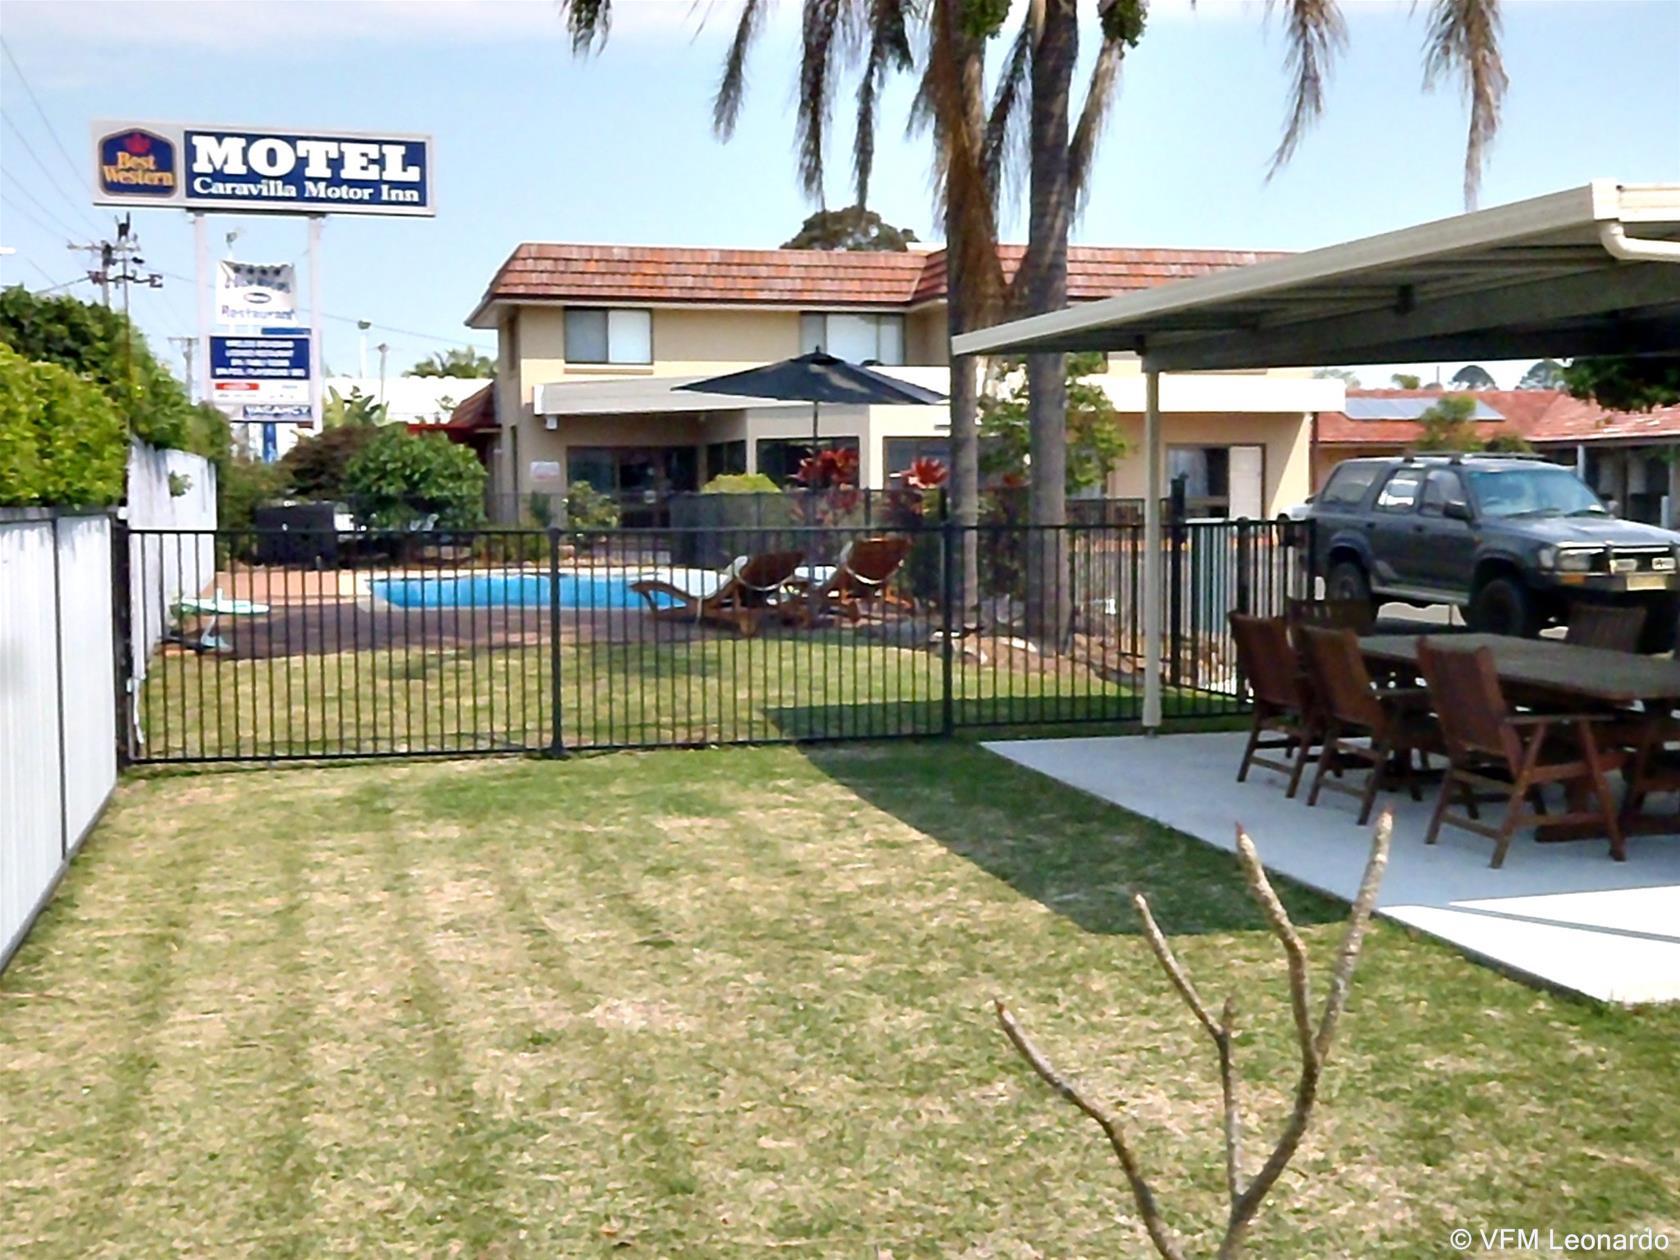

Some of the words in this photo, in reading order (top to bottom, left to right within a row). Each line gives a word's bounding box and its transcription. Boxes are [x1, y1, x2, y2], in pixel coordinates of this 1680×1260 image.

[117, 151, 156, 170] Best
[192, 135, 420, 182] MOTEL
[103, 164, 174, 187] Western
[193, 177, 297, 198] Caravilla
[304, 180, 374, 200] Motor
[380, 184, 419, 202] Inn
